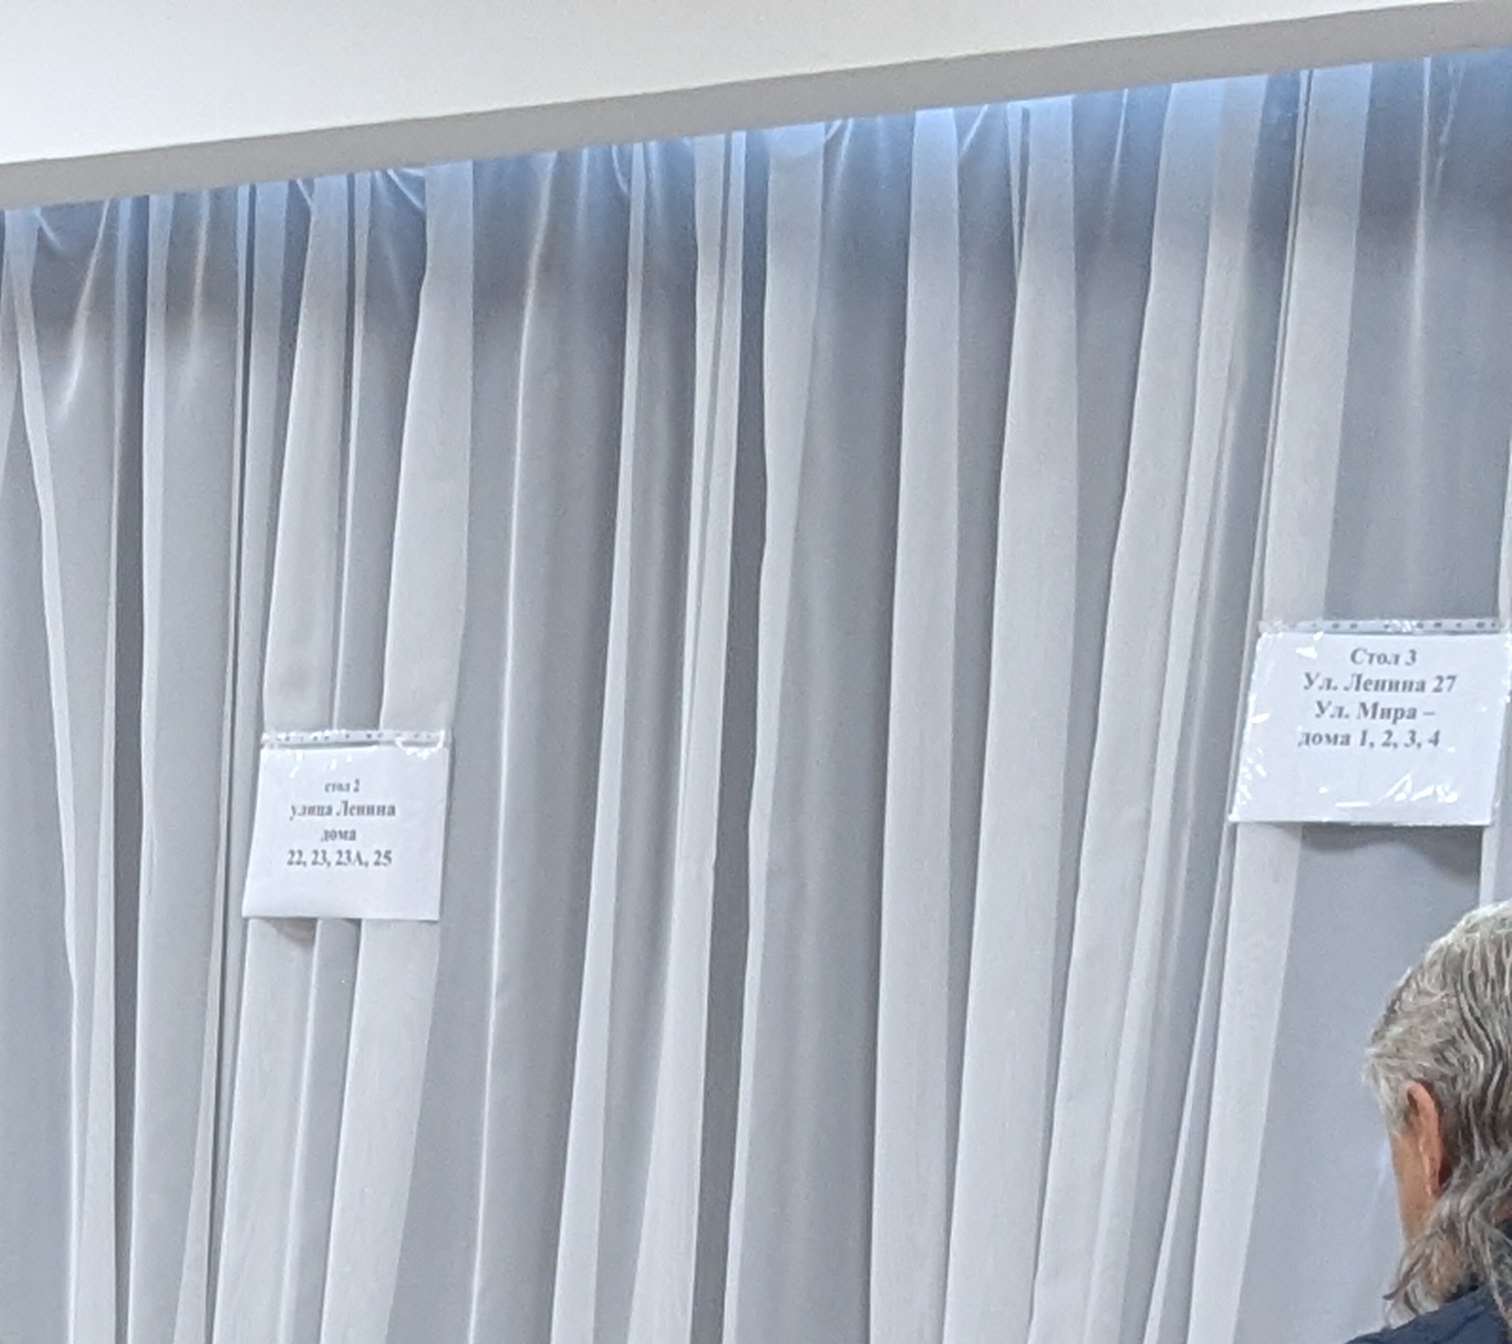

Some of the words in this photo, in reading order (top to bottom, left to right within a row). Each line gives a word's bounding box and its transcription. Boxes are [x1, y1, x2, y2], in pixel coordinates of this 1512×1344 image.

[1350, 648, 1400, 666] Стол
[1404, 649, 1417, 666] 3
[1303, 672, 1338, 691] Ул.
[1343, 673, 1426, 692] Ленина
[1432, 675, 1457, 693] 27
[1315, 701, 1351, 719] Ул.
[1356, 702, 1417, 724] Мира
[1298, 731, 1351, 747] дома
[1359, 730, 1375, 749] 1,
[1381, 730, 1399, 749] 2,
[1404, 730, 1423, 749] 3,
[1428, 730, 1441, 747] 4
[353, 779, 360, 792] 2
[289, 803, 332, 820] улица
[336, 801, 395, 816] Ленина
[321, 829, 356, 842] дома
[287, 850, 307, 867] 22,
[311, 850, 331, 867] 23,
[335, 850, 369, 867] 23А,
[373, 850, 392, 866] 25
